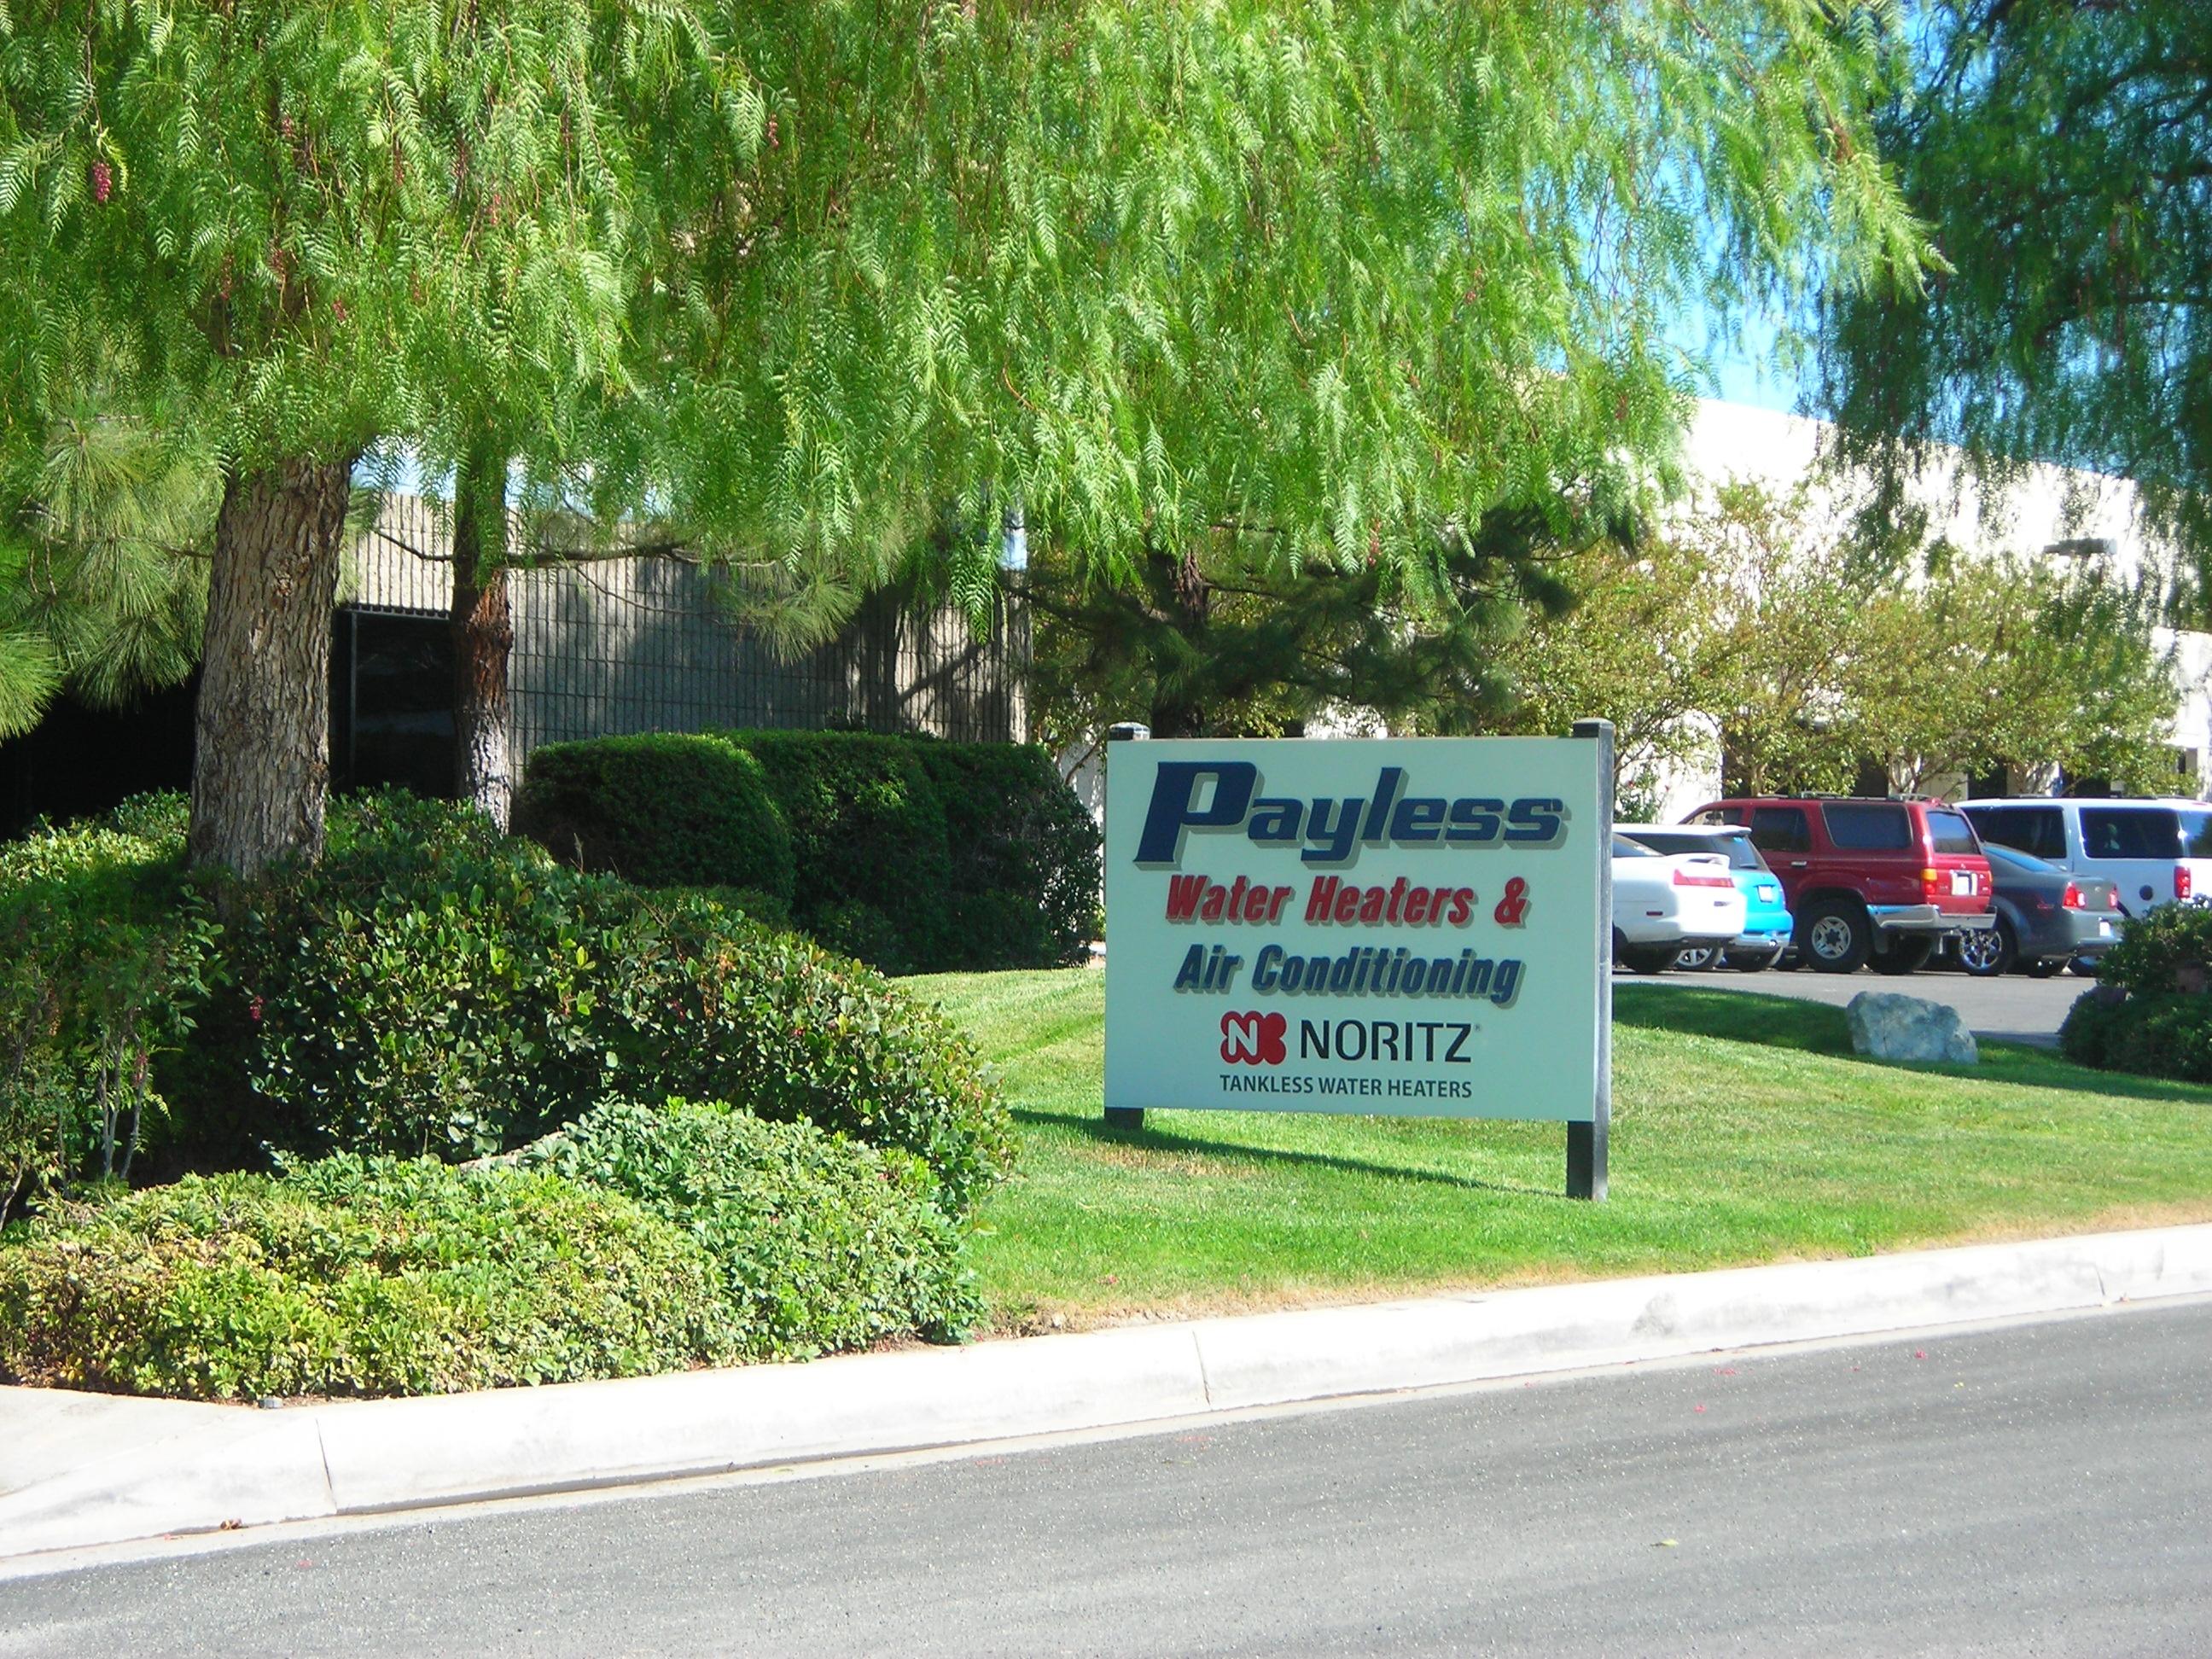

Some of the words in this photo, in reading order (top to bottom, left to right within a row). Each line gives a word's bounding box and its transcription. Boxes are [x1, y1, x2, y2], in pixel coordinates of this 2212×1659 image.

[1132, 760, 1571, 870] Payless
[1165, 875, 1295, 924] Water
[1304, 876, 1478, 928] Heaters
[1493, 876, 1530, 928] &
[1173, 944, 1243, 994] Air
[1252, 945, 1526, 1007] Conditioning
[1220, 1074, 1313, 1093] TANKLESS
[1318, 1076, 1382, 1096] WATER
[1387, 1080, 1472, 1098] HEATERS
